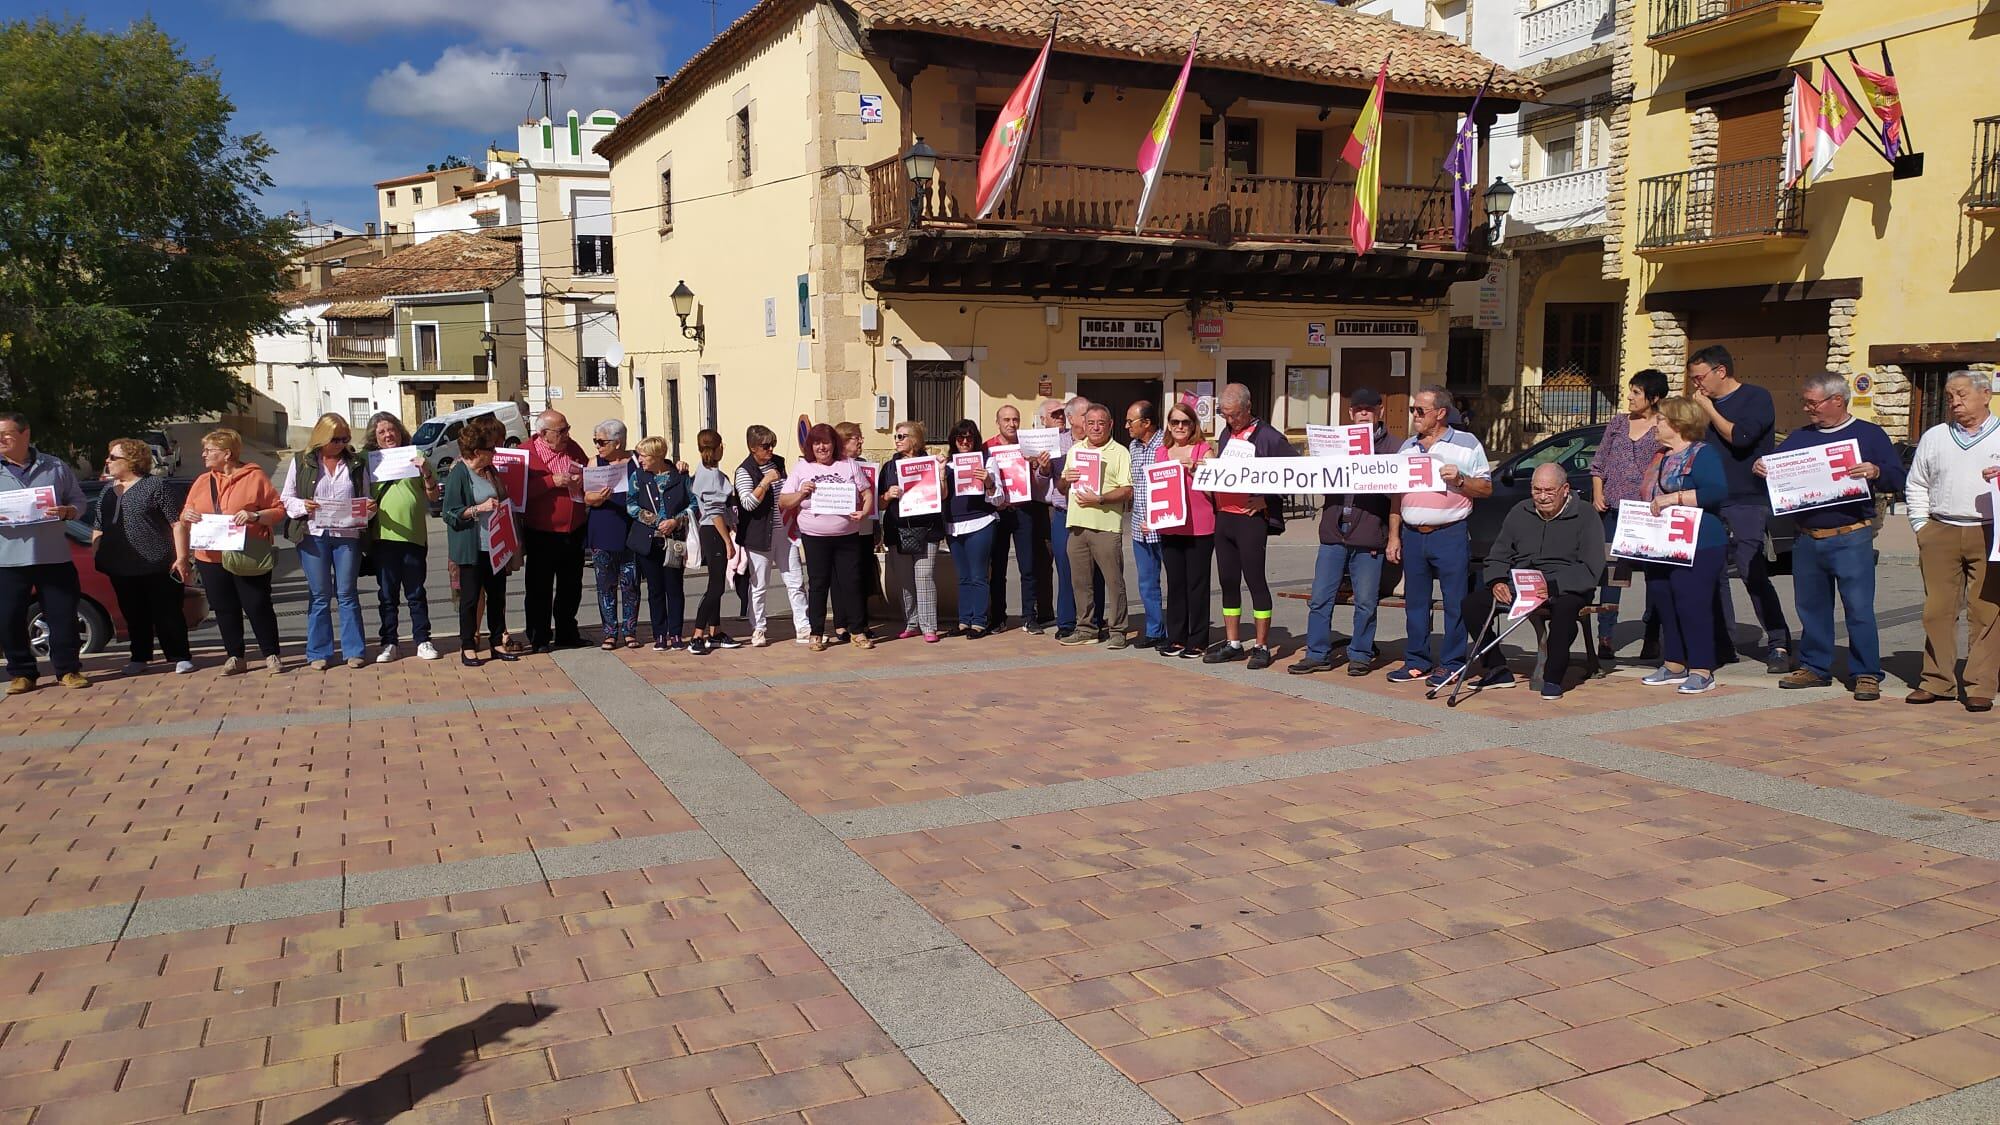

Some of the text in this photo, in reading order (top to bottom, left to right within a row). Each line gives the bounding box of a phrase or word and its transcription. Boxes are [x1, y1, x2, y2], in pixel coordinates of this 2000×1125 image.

[1086, 321, 1156, 333] HOGAR DEL
[1339, 322, 1417, 333] AYUNTAMIENTO
[1082, 336, 1160, 348] PENSIONISTA
[1223, 449, 1254, 459] apace
[1775, 457, 1817, 469] DESPOBLACIÓN
[1198, 460, 1398, 488] #Yo Paro Por Mi Pueblo
[1353, 482, 1398, 491] Cardenete
